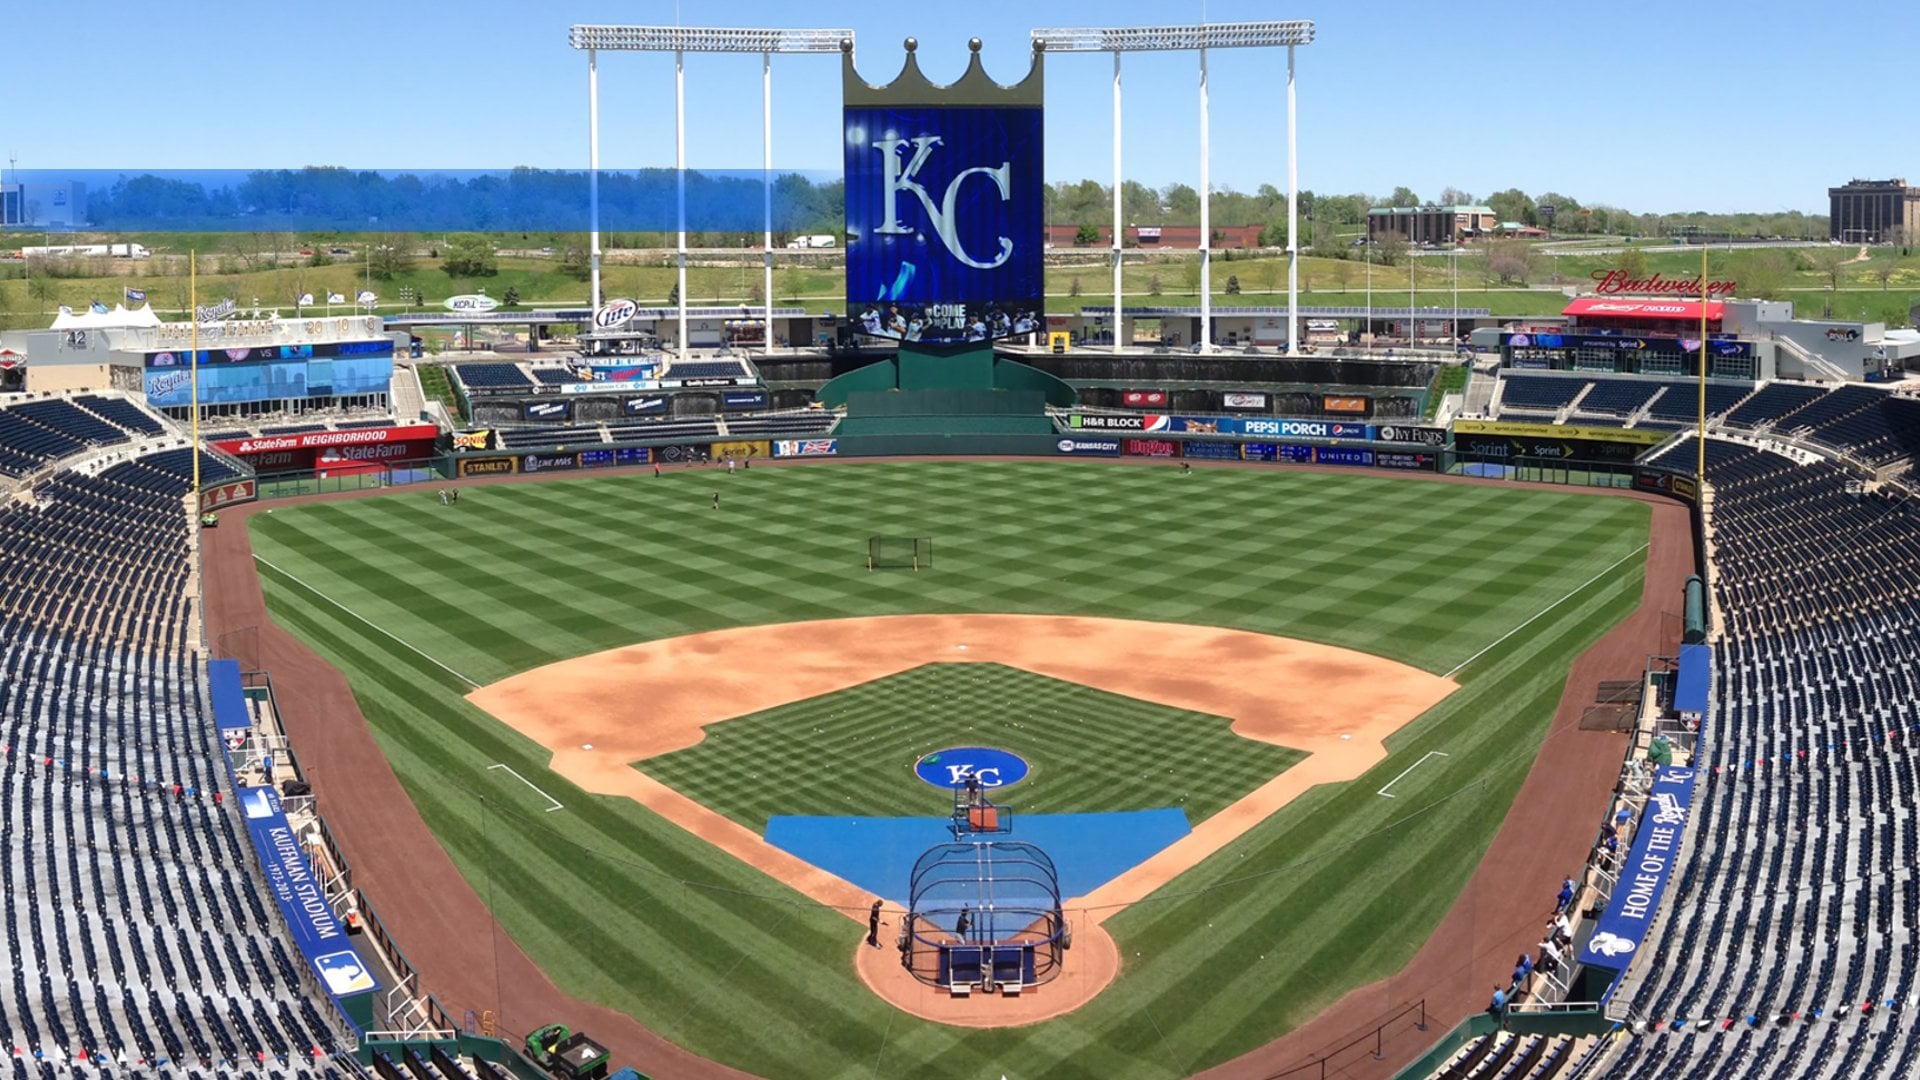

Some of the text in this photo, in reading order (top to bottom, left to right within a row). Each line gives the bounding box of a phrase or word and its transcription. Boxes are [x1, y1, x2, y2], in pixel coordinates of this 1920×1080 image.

[872, 136, 1013, 269] KC
[604, 306, 633, 326] Lite
[933, 304, 966, 316] COME
[225, 319, 274, 337] FAME
[307, 321, 323, 335] 20
[335, 318, 349, 332] 10
[941, 317, 966, 329] PLAY
[66, 330, 87, 345] 42
[1618, 340, 1638, 349] Sprint
[150, 370, 193, 398] Royals
[1083, 417, 1142, 428] H&R BLOCK
[1245, 420, 1327, 436] PEPSI PORCH
[302, 430, 387, 446] NEIGHBORHOOD
[453, 434, 487, 446] SONIC
[1075, 441, 1101, 450] KANSAS
[1102, 442, 1118, 450] CITY
[1469, 440, 1509, 457] Sprint
[1534, 445, 1561, 456] Sprint
[1320, 452, 1361, 462] UNITED
[467, 461, 510, 473] STANLEY
[946, 764, 1003, 787] KC
[1620, 792, 1687, 920] HOME OF THE Royals
[268, 826, 340, 940] KAUFFMAN STADIUM
